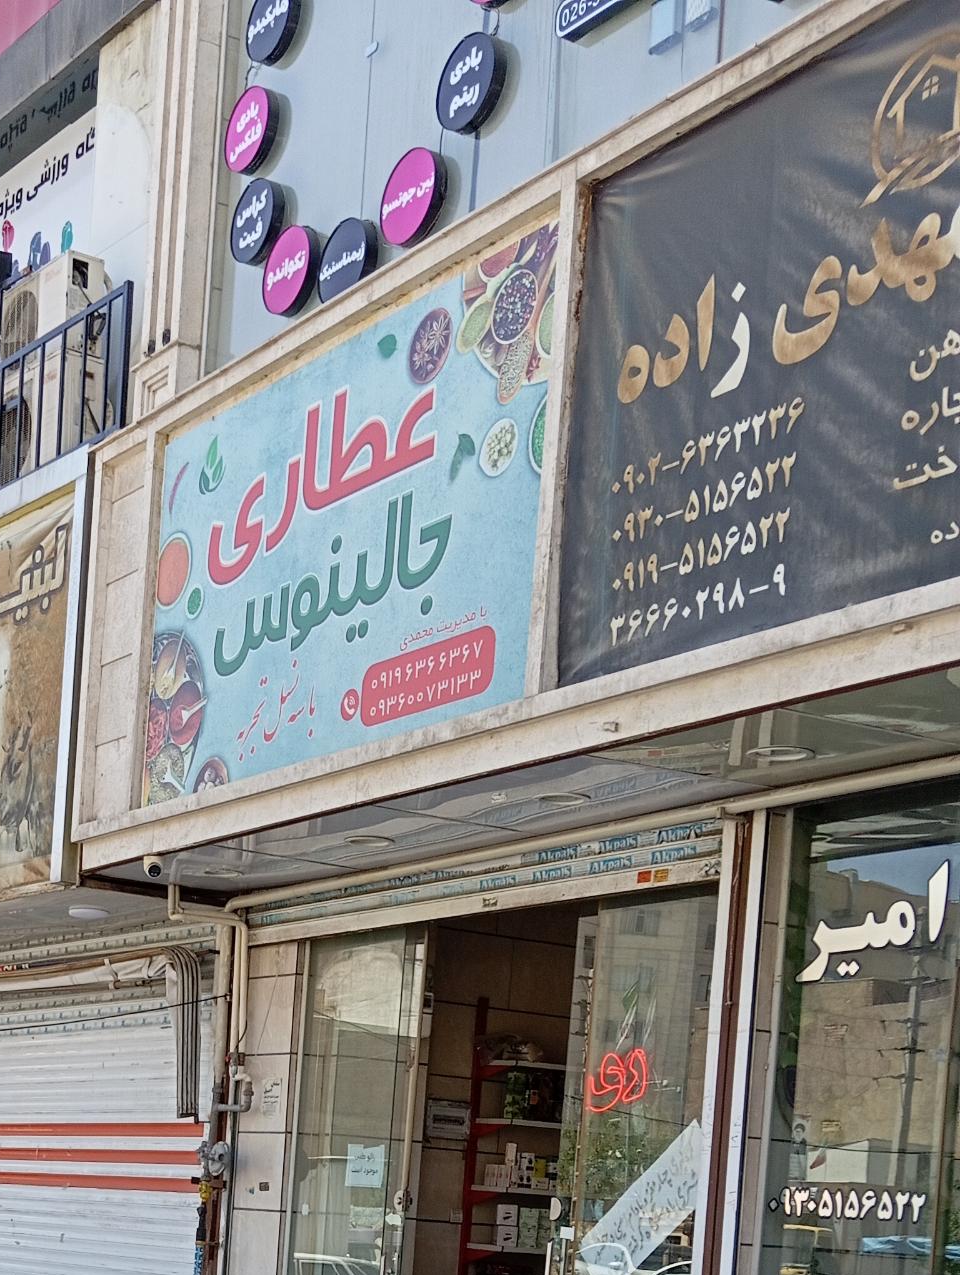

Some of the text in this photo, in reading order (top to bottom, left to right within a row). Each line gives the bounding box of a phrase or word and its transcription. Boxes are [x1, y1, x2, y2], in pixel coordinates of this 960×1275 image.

[449, 46, 484, 86] بادی
[229, 118, 262, 163] فلکس
[236, 102, 259, 133] بادی
[26, 153, 70, 201] ورزشی
[236, 189, 268, 228] کراس
[238, 220, 263, 250] فیت
[266, 252, 306, 291] تکواندو
[617, 272, 751, 404] زاده
[208, 386, 436, 586] عطاری
[214, 490, 453, 676] جالینوس
[399, 604, 488, 652] با مدیریت محمدی
[796, 860, 952, 983] امیر
